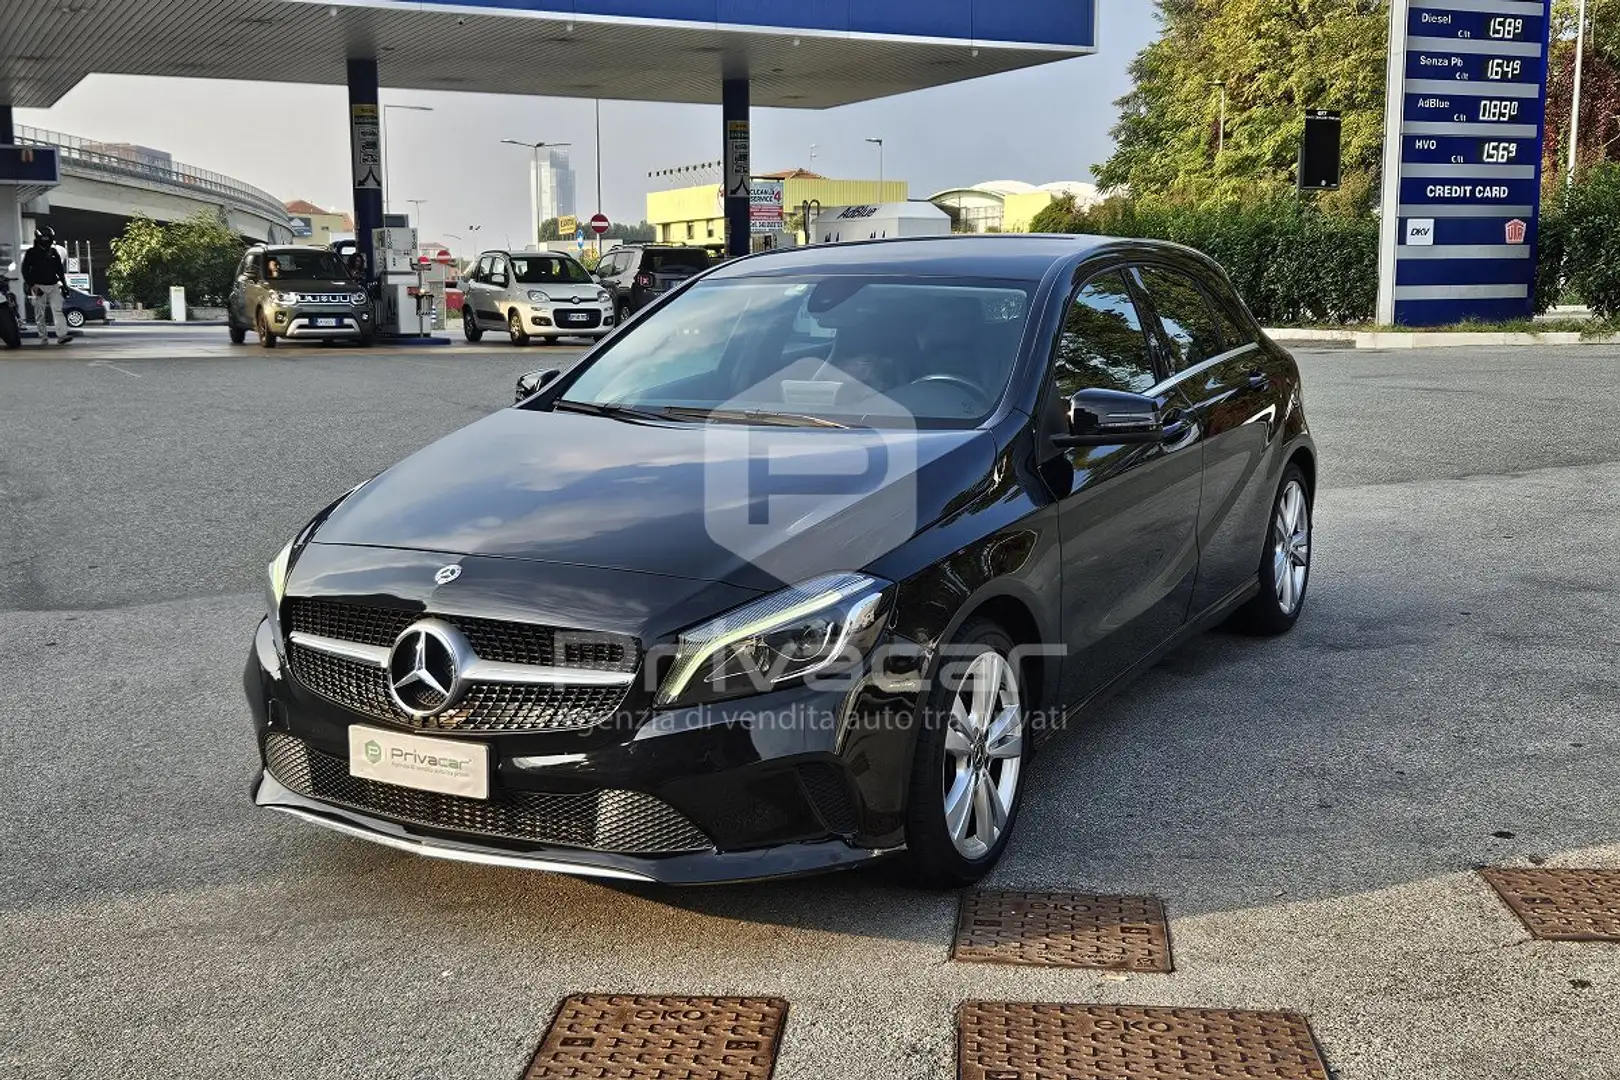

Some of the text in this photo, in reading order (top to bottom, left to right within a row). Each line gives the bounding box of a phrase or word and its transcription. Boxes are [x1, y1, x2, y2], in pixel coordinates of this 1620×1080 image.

[1421, 13, 1452, 24] Diesel
[1420, 55, 1464, 67] Senza Pb
[1417, 98, 1450, 108] AdBlue
[1415, 139, 1437, 149] HVO
[1426, 185, 1508, 198] CREDIT CARD
[837, 205, 879, 219] AdBlue
[1410, 227, 1430, 236] DKV
[390, 747, 470, 770] Privacar
